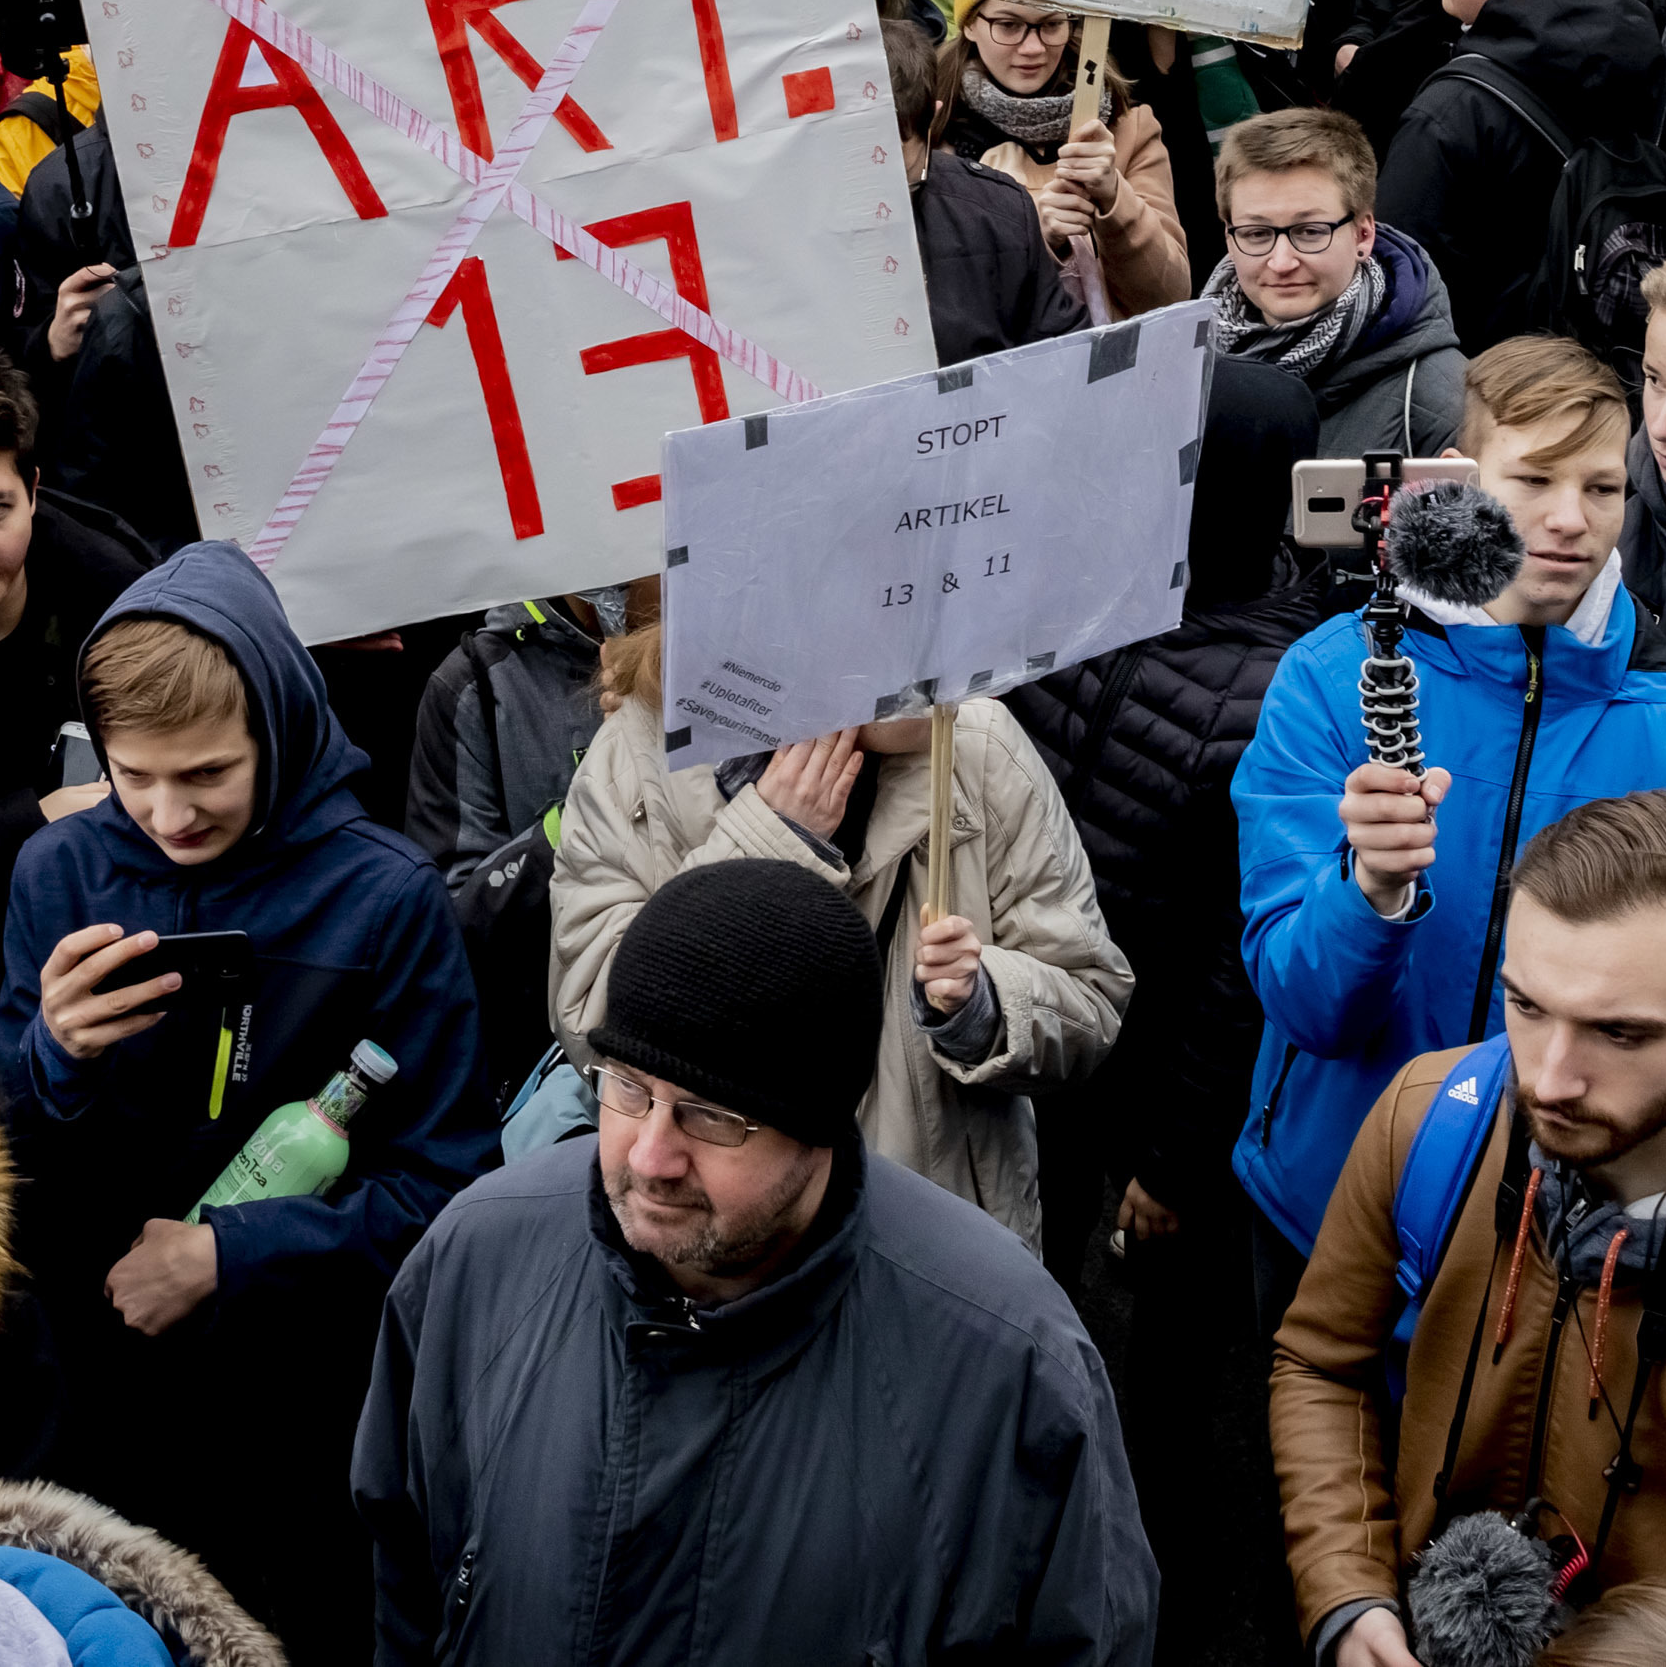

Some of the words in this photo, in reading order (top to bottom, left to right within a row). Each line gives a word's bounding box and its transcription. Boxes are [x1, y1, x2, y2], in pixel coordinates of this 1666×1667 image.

[426, 199, 735, 541] 13
[915, 414, 1008, 455] STOPT
[894, 493, 1011, 534] ARTIKEL
[880, 583, 915, 609] 13
[940, 572, 961, 594] &
[982, 552, 1012, 578] 11
[1447, 1087, 1480, 1107] adidas
